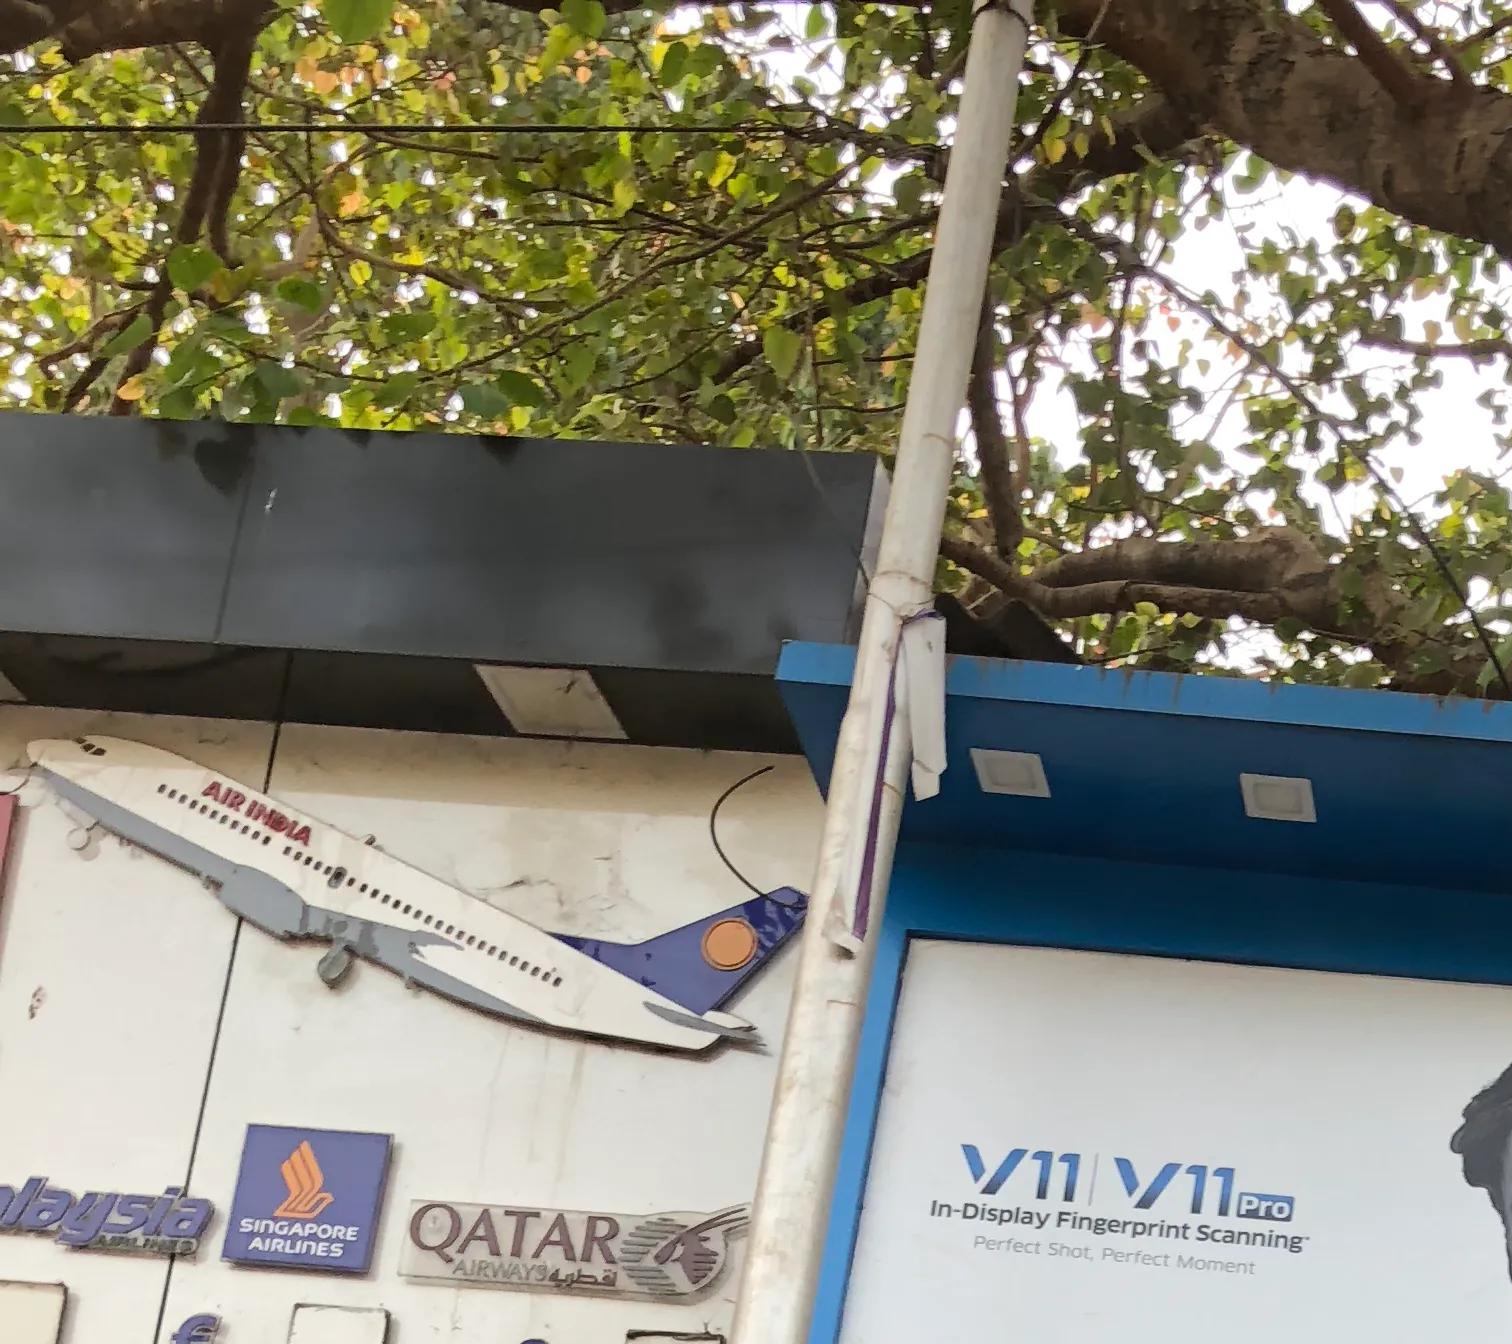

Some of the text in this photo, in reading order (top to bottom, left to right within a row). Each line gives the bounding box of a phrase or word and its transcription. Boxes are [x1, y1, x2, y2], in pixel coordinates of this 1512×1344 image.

[201, 779, 312, 848] AIR INDIA
[960, 1143, 1292, 1220] V11 V11 Pro
[239, 1217, 360, 1242] SINGAPORE
[410, 1202, 621, 1265] QATAR
[930, 1199, 1051, 1231] In-Display
[1055, 1211, 1191, 1242] Fingerprint
[248, 1236, 345, 1258] AIRLINES
[973, 1234, 1256, 1276] Perfect Shot, Perfect Moment
[452, 1259, 549, 1283] AIRWAYS
